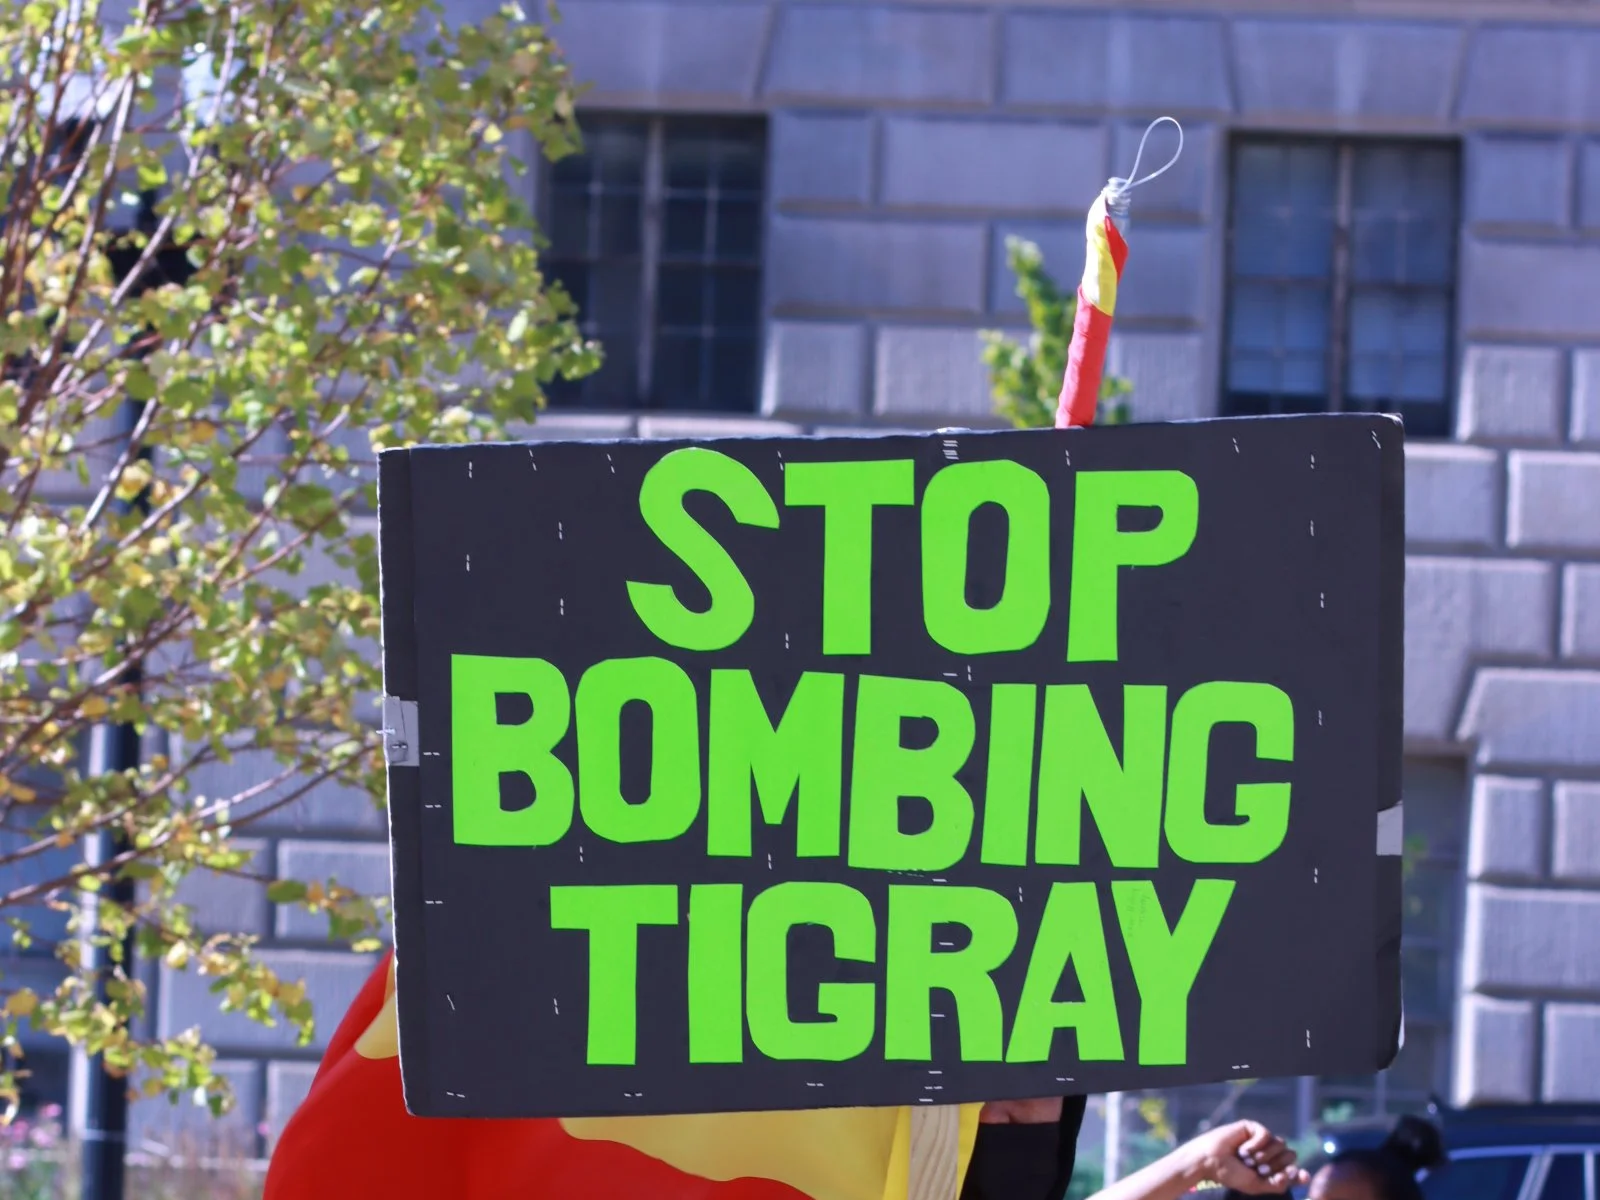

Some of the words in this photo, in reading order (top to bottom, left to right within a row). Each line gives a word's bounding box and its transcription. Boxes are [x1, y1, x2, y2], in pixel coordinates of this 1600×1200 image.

[626, 447, 1199, 662] STOP
[451, 654, 1295, 871] BOMBING
[550, 880, 1235, 1065] TIGRAY
